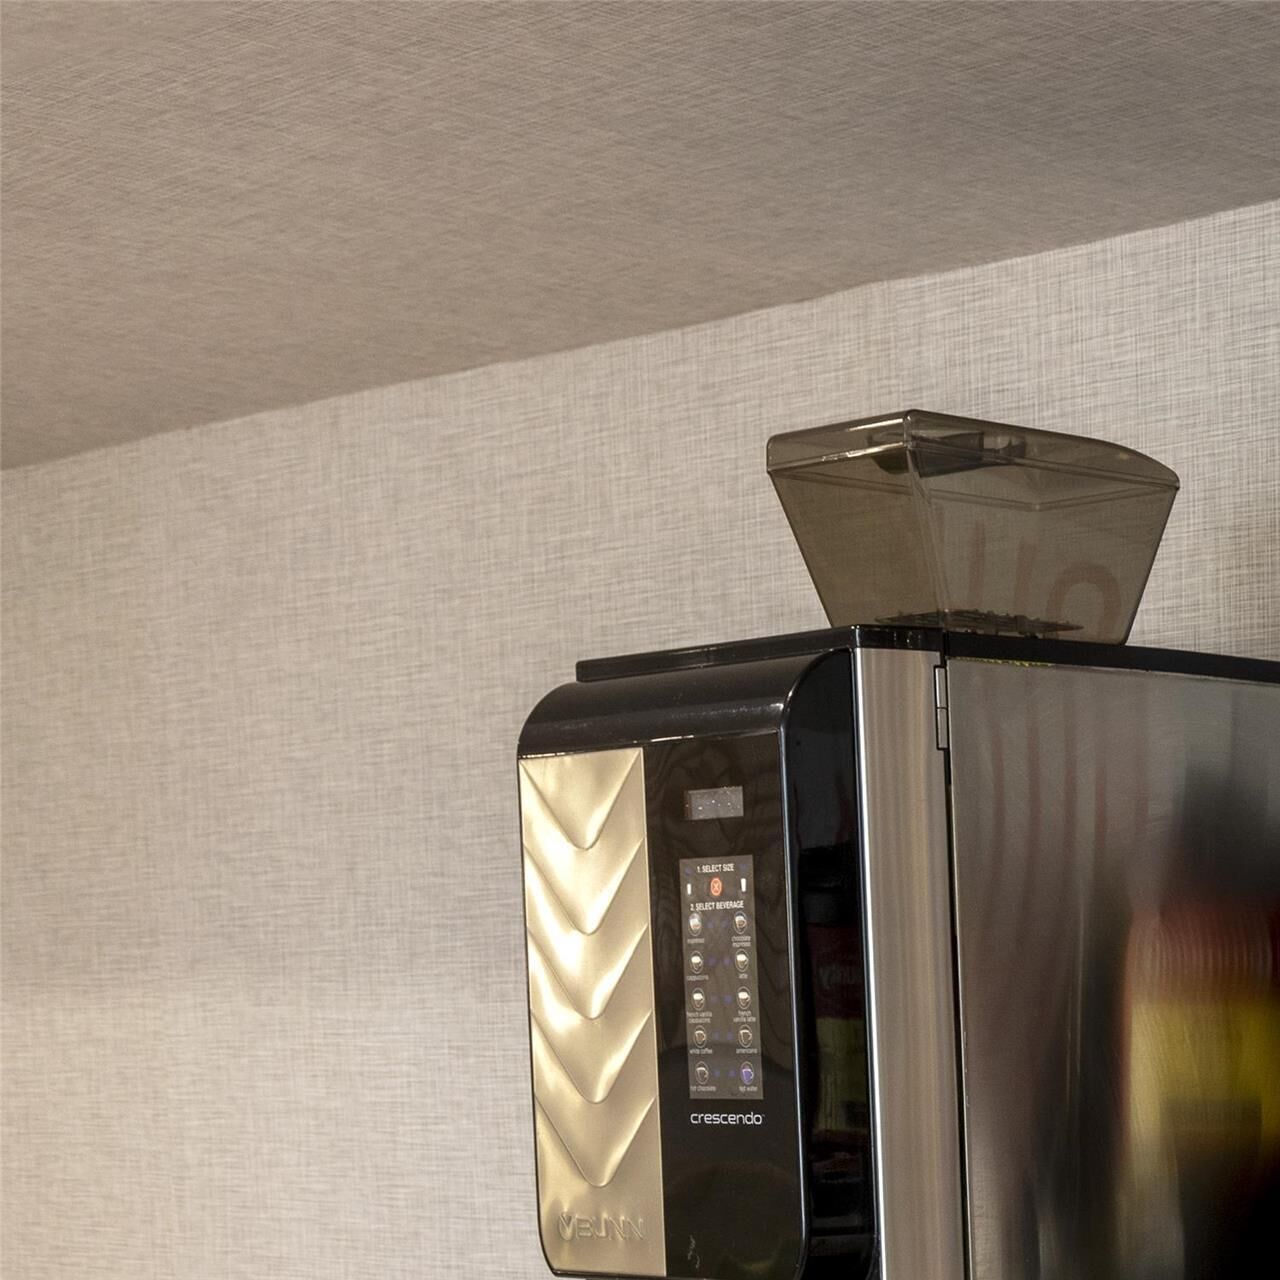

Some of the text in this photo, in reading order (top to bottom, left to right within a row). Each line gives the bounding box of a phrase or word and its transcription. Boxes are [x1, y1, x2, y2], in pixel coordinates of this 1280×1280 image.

[702, 864, 722, 873] SELECT
[722, 863, 734, 871] SIZE
[696, 902, 715, 910] SELECT
[716, 900, 744, 910] BEVERAGE
[690, 1112, 762, 1125] crescendo
